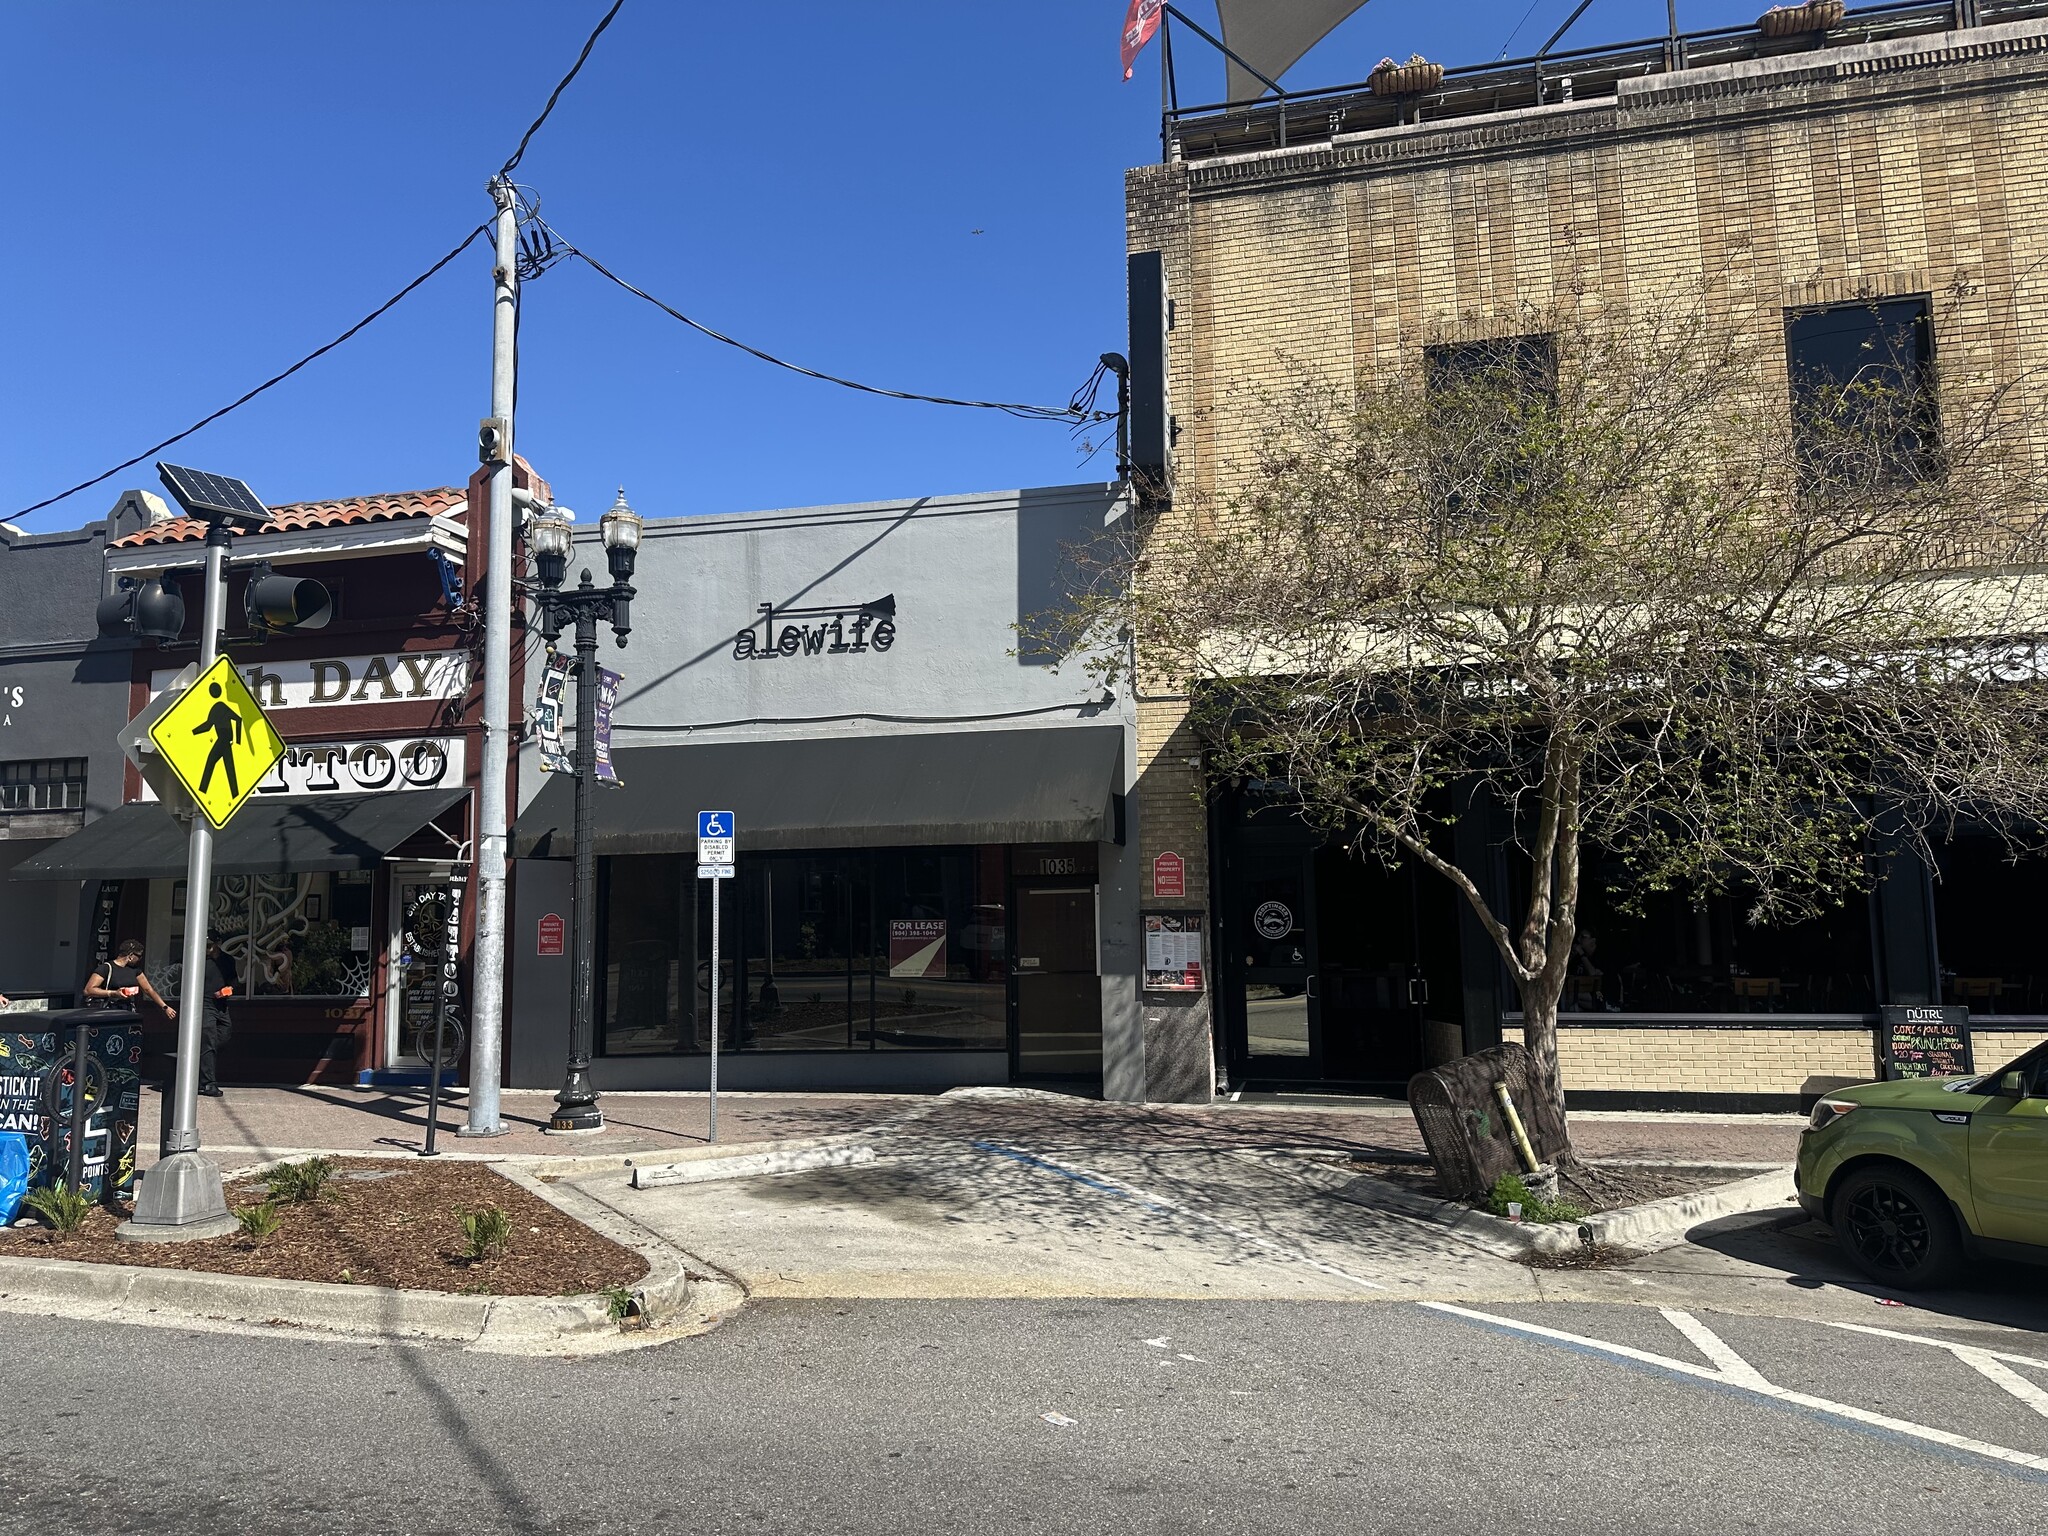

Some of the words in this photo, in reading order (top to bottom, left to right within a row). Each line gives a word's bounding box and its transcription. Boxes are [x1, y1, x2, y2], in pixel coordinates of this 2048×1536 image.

[735, 600, 896, 656] alewife
[309, 653, 442, 703] DAY
[254, 740, 448, 794] TTOO
[1042, 859, 1074, 875] 1035
[1157, 875, 1166, 885] NO
[418, 891, 437, 904] DAY
[892, 922, 913, 930] FOR
[914, 922, 944, 930] LEASE
[1910, 1037, 1944, 1050] BRUNCH
[30, 1076, 41, 1097] IT
[0, 1098, 9, 1110] N
[12, 1098, 36, 1111] THE
[553, 1120, 573, 1130] 1033
[82, 1163, 110, 1179] POINTS
